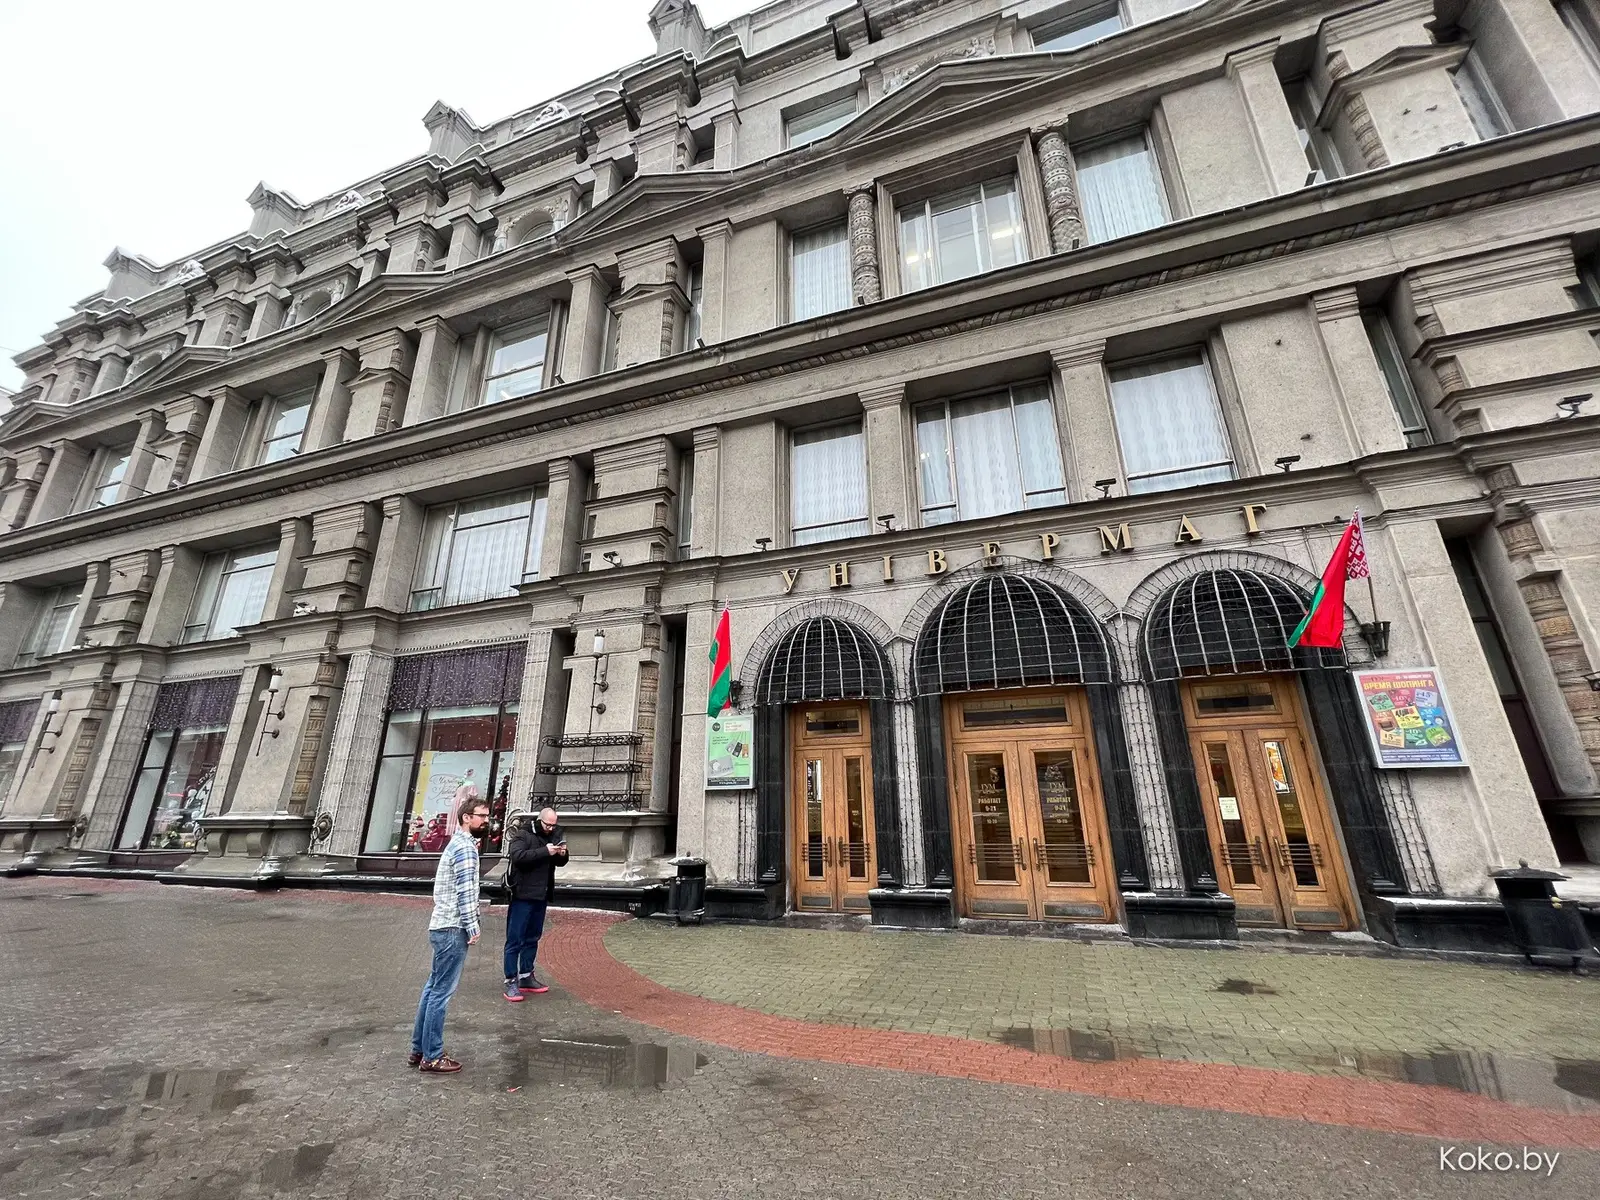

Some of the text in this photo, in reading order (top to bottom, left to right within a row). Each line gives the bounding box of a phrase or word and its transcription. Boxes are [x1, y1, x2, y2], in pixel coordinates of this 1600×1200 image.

[780, 503, 1267, 594] УНІВЕРМАГ
[1363, 680, 1434, 690] ВРЕМЯ ШОПИНГА
